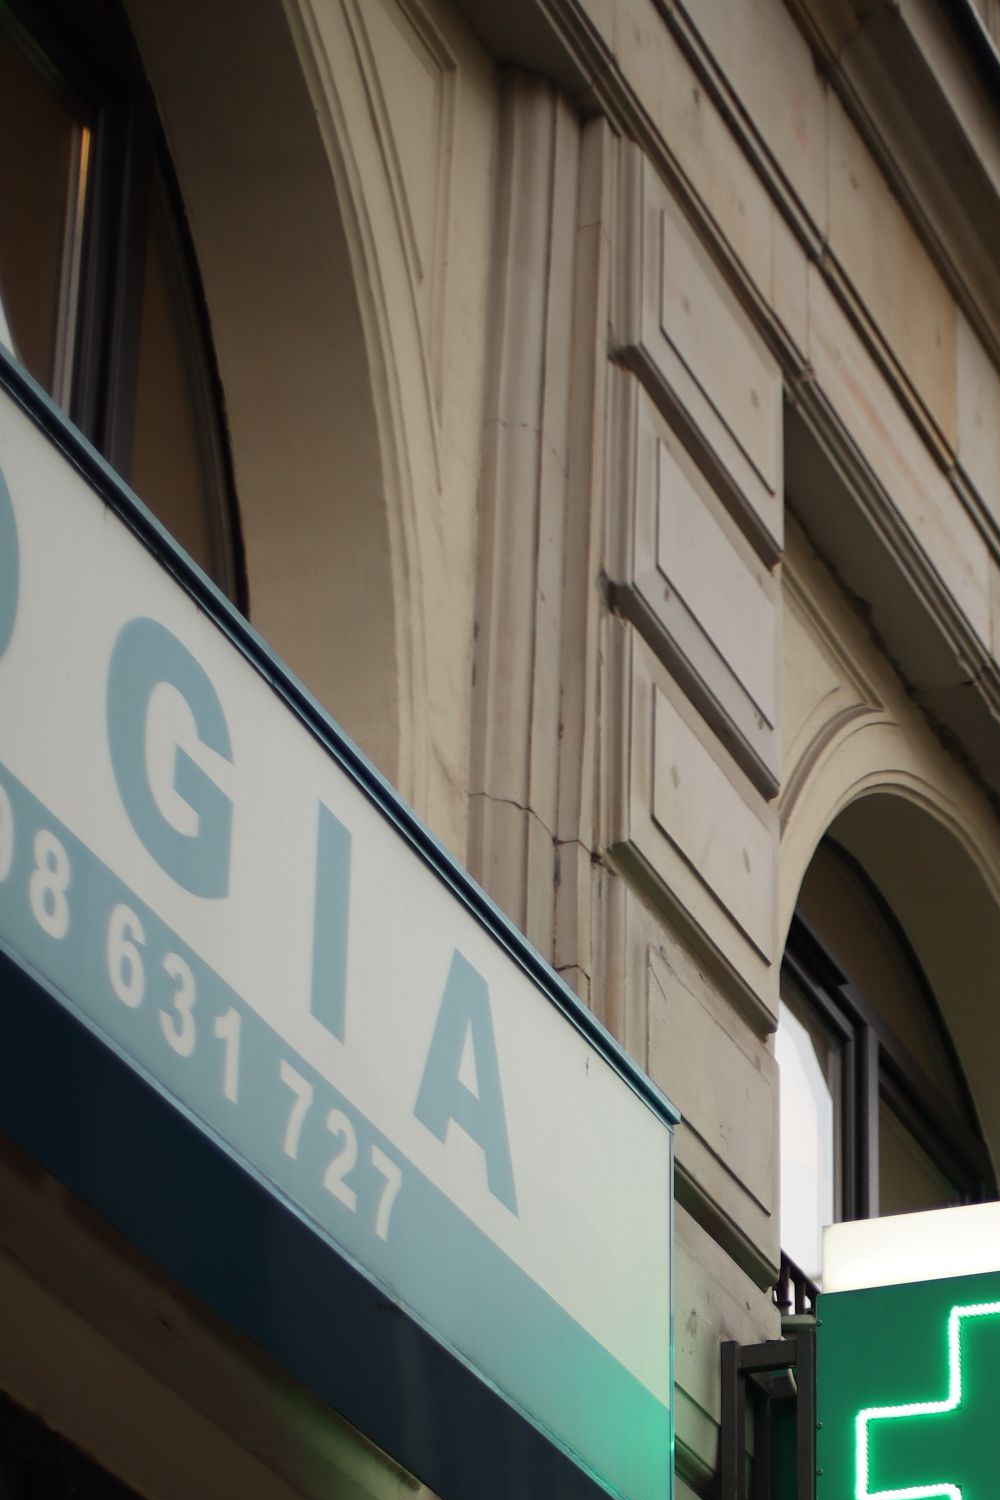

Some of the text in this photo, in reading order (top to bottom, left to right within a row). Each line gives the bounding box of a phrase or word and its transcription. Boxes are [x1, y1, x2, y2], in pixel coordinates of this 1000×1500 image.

[0, 466, 520, 1219] GIA
[107, 903, 241, 1105] 631
[278, 1060, 402, 1242] 727
